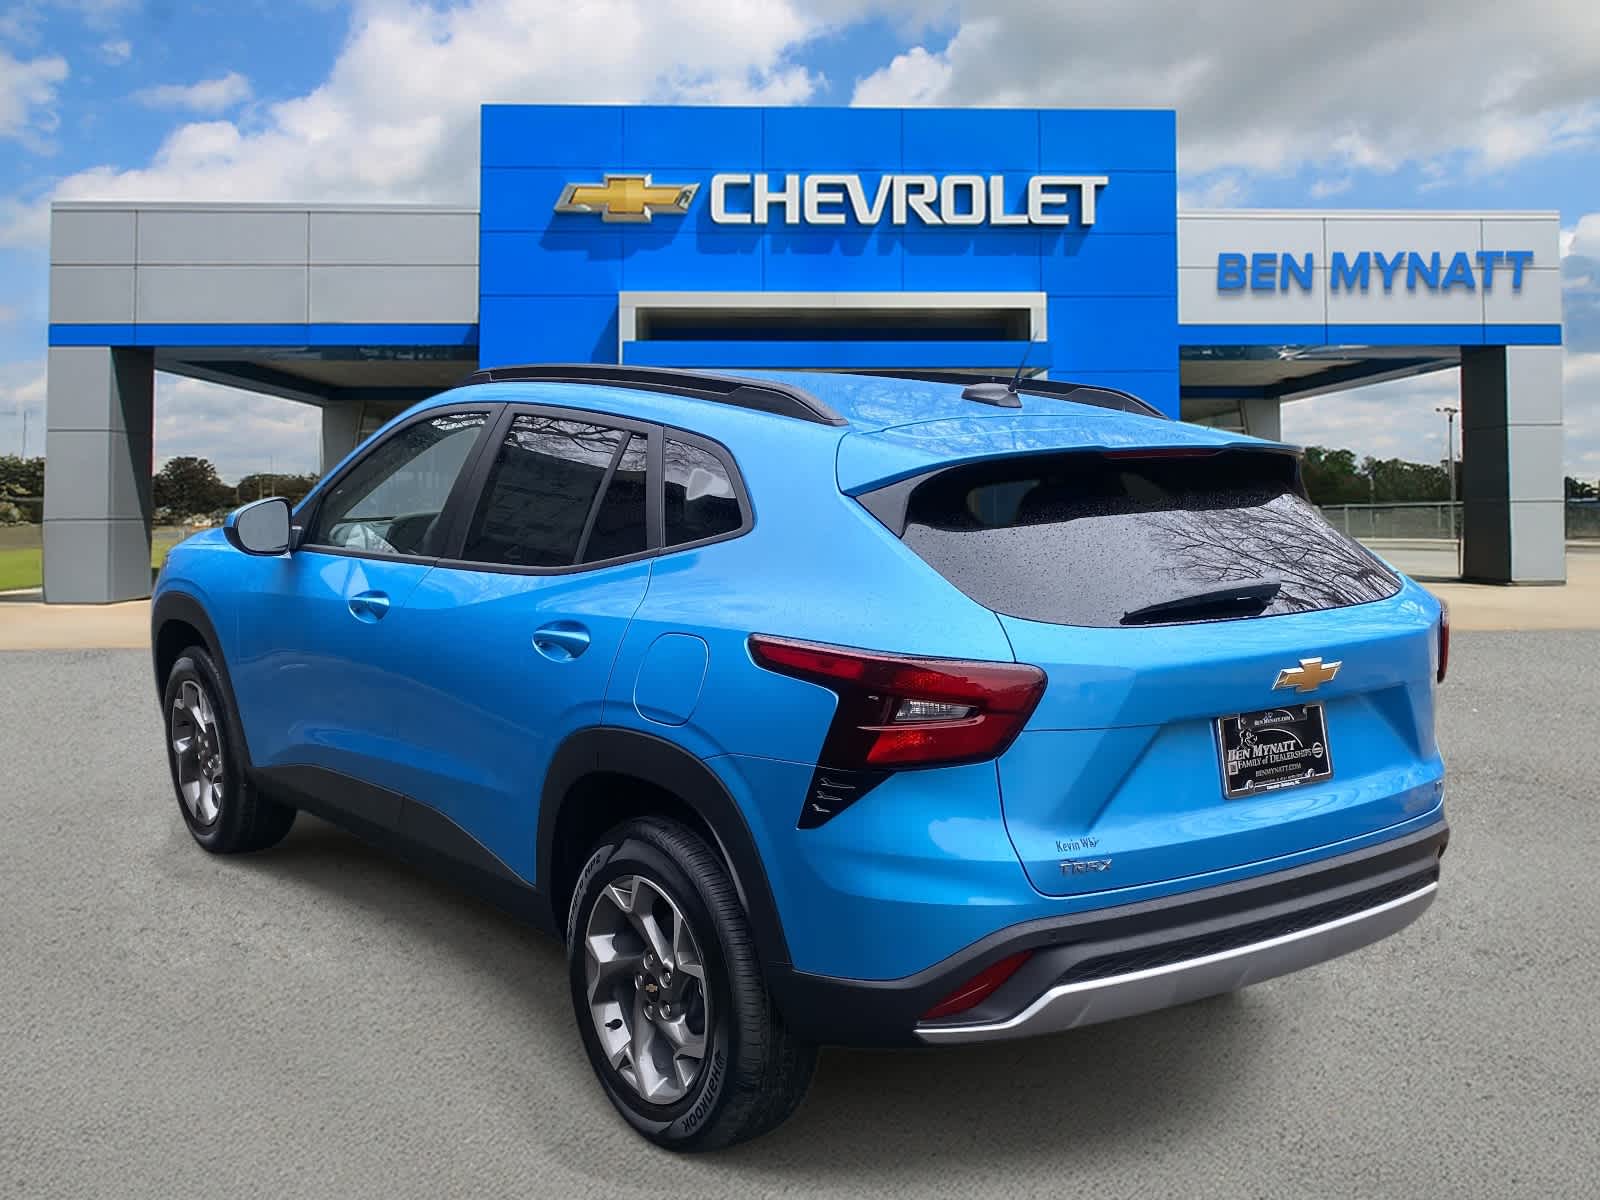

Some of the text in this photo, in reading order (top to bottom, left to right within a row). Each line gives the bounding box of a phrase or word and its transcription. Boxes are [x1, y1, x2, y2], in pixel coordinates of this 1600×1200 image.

[711, 173, 1109, 225] CHEVROLET
[1217, 250, 1534, 291] BEN MYNATT
[1227, 740, 1297, 762] BEN MYNATT
[1238, 758, 1262, 770] FAMILY
[1056, 838, 1080, 852] Kevin
